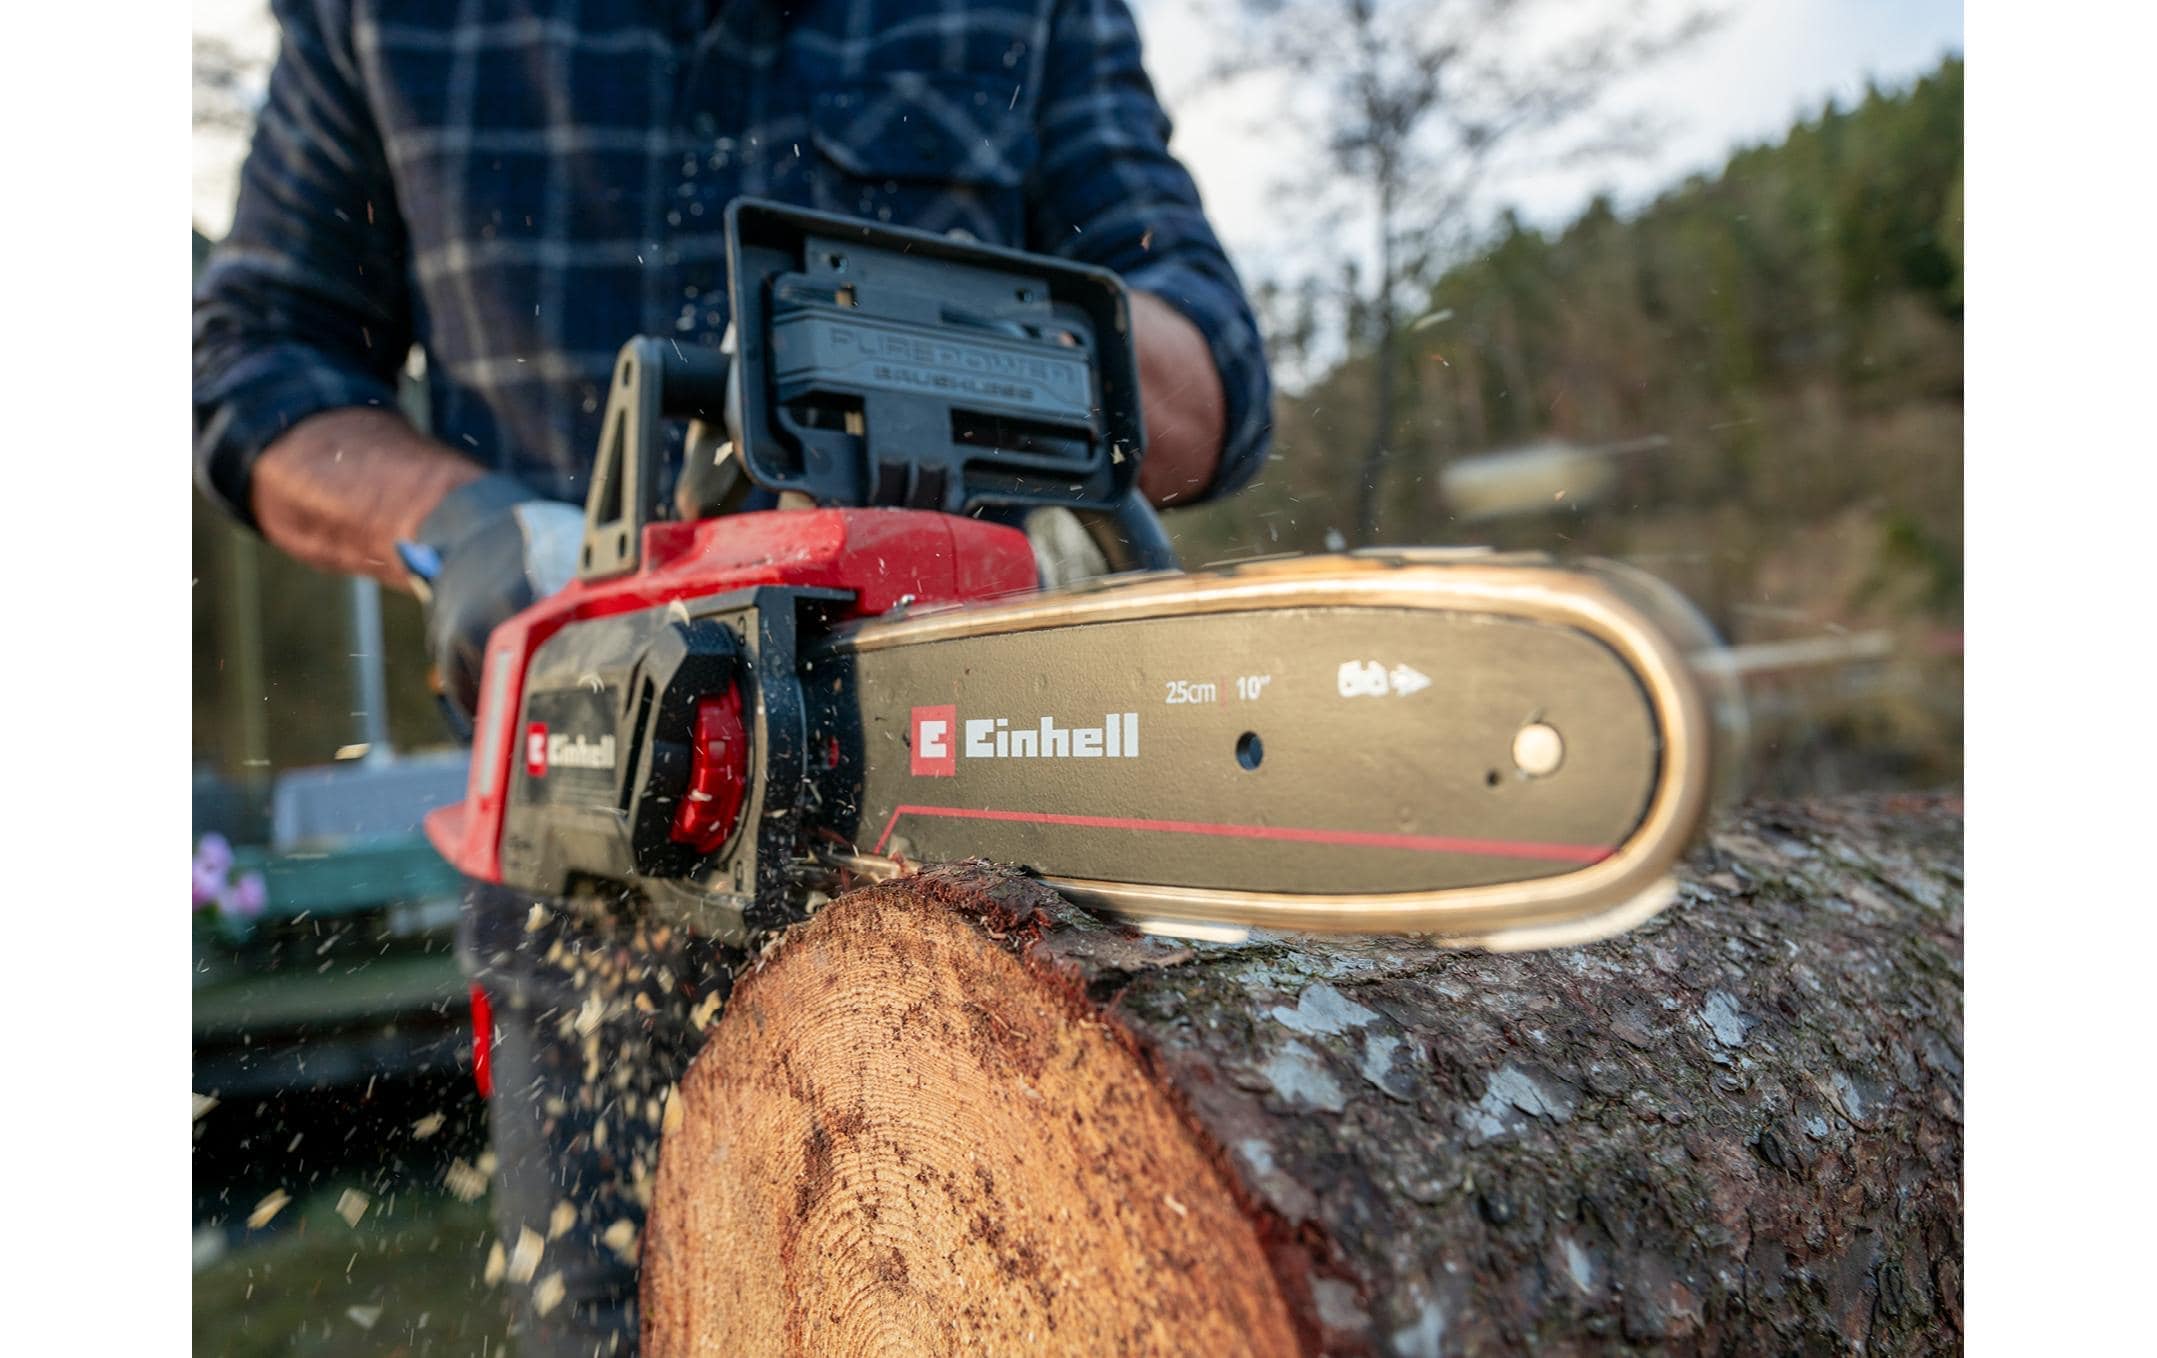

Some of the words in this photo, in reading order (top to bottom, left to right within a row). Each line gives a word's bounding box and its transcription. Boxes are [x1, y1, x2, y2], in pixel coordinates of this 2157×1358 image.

[1165, 680, 1216, 704] 25cm
[549, 733, 615, 768] Einhell
[965, 712, 1139, 758] Einhell
